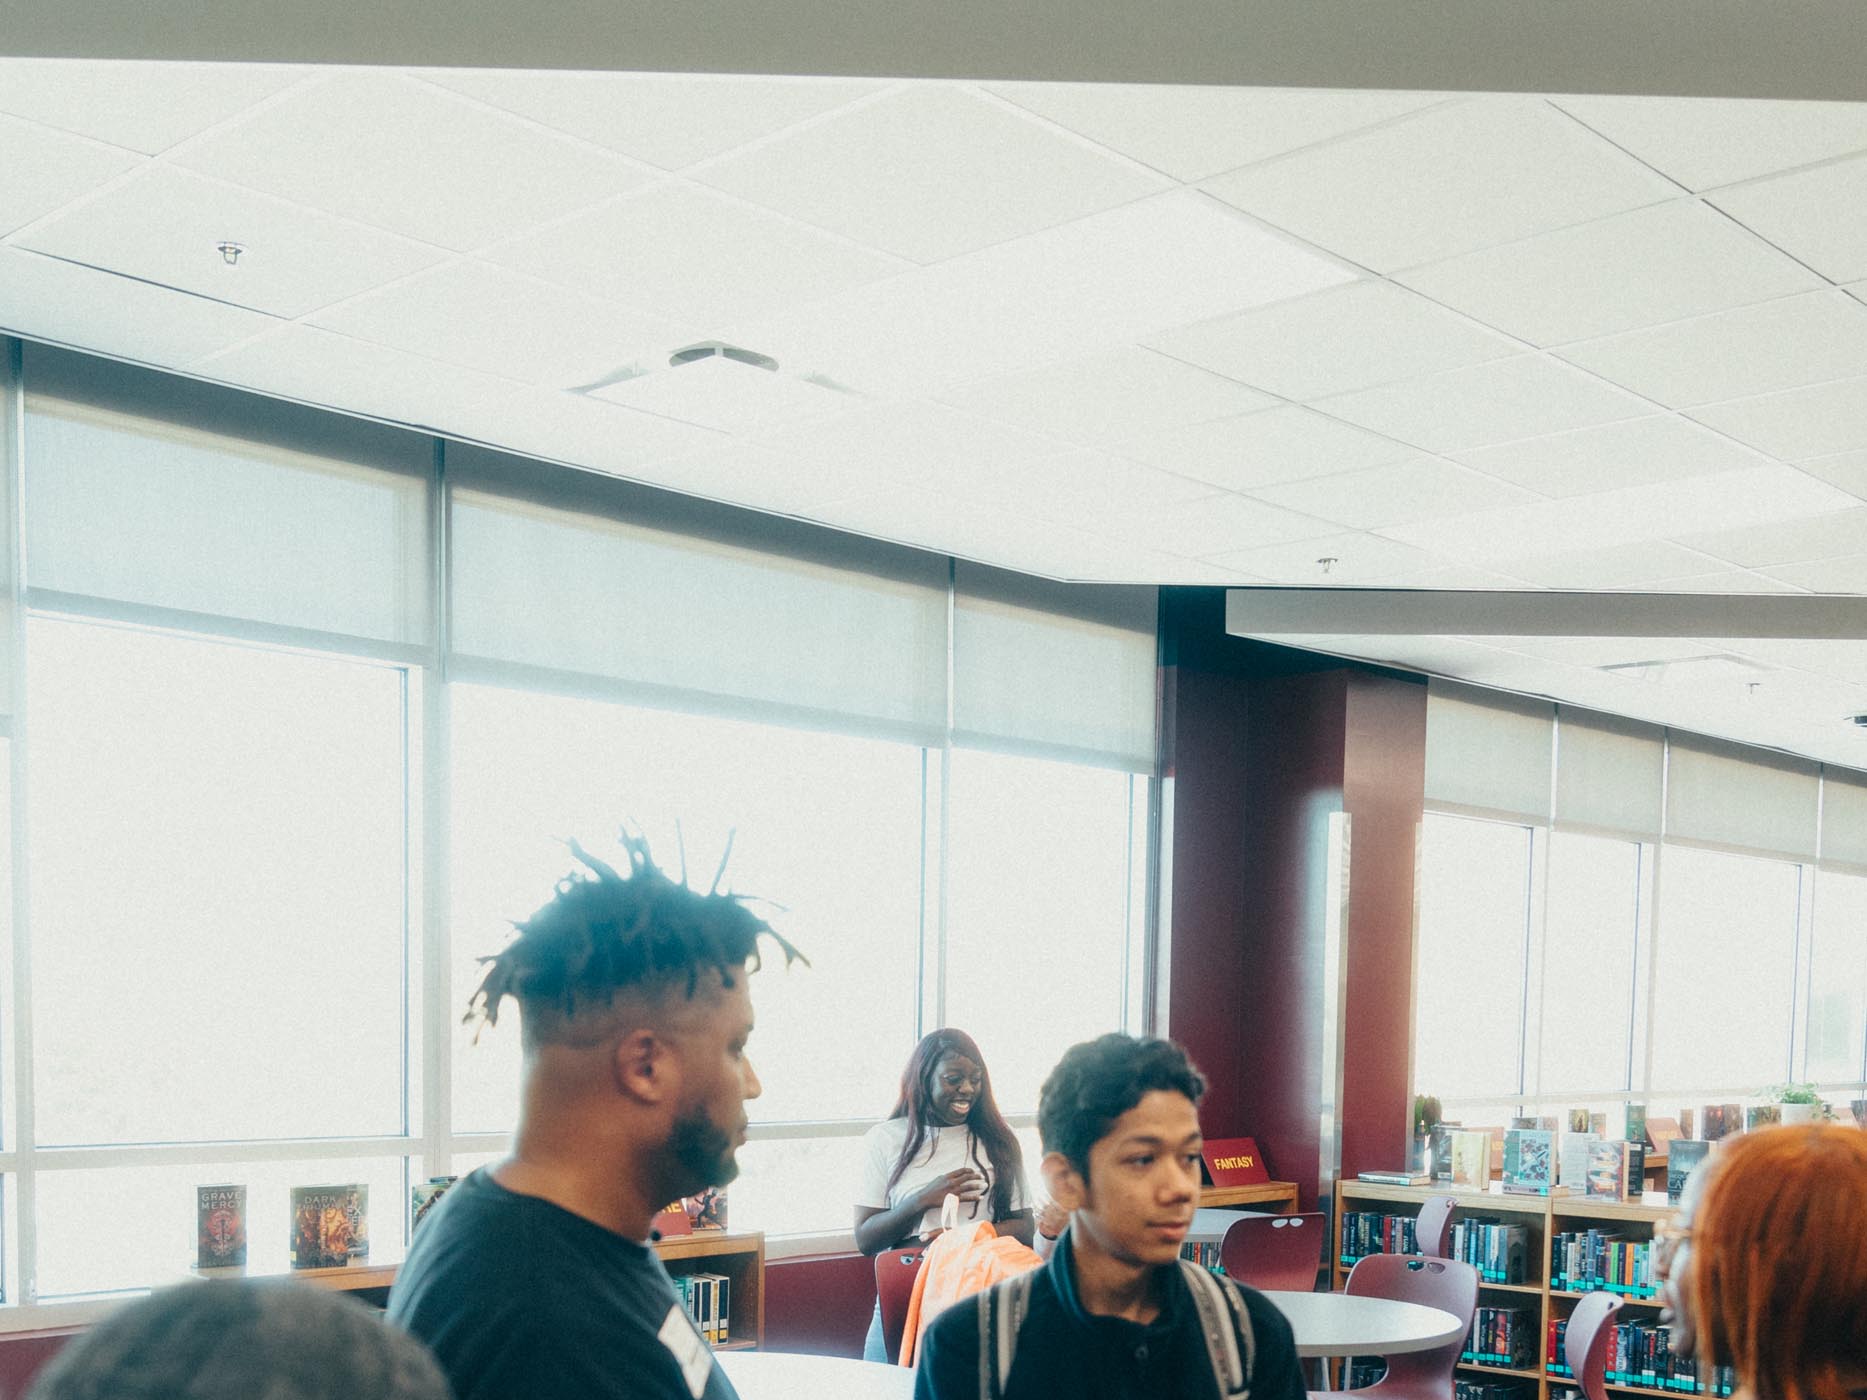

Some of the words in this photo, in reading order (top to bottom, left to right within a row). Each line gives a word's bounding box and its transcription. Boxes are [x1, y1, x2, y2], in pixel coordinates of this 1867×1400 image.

[1213, 1156, 1254, 1170] FANTASY
[201, 1191, 242, 1202] GRAVE
[201, 1199, 242, 1210] MERCY
